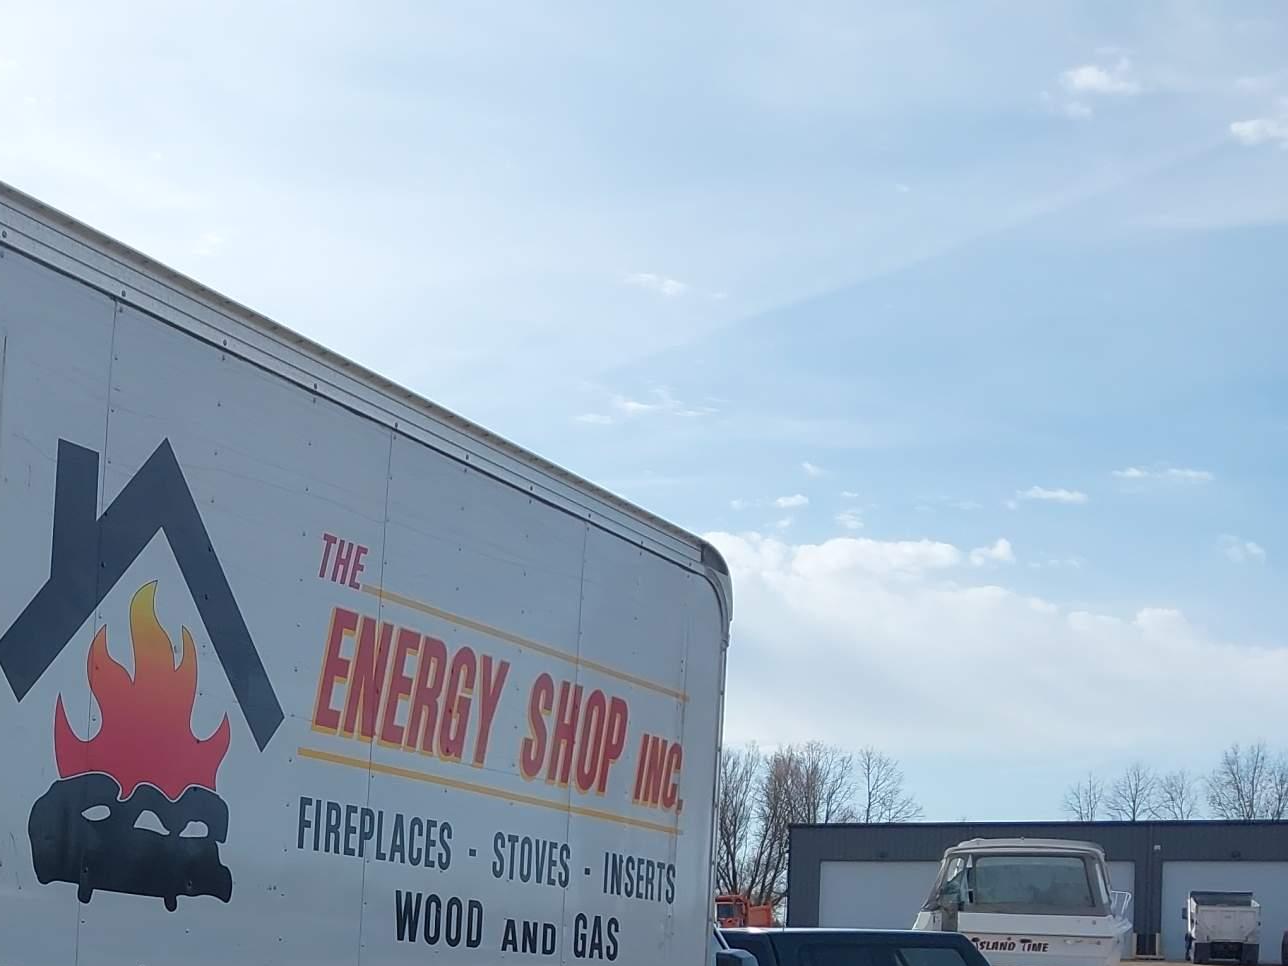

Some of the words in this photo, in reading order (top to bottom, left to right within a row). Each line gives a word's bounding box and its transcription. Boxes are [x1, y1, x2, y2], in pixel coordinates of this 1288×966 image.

[318, 534, 369, 590] THE
[312, 607, 511, 769] ENERGY
[519, 672, 630, 796] SHOP
[632, 733, 684, 817] INC.
[297, 797, 452, 871] FIREPLACES
[492, 831, 571, 889] STOVES
[603, 852, 676, 904] INSERTS
[395, 890, 483, 948] WOOD
[501, 918, 556, 955] AND
[573, 912, 620, 961] GAS
